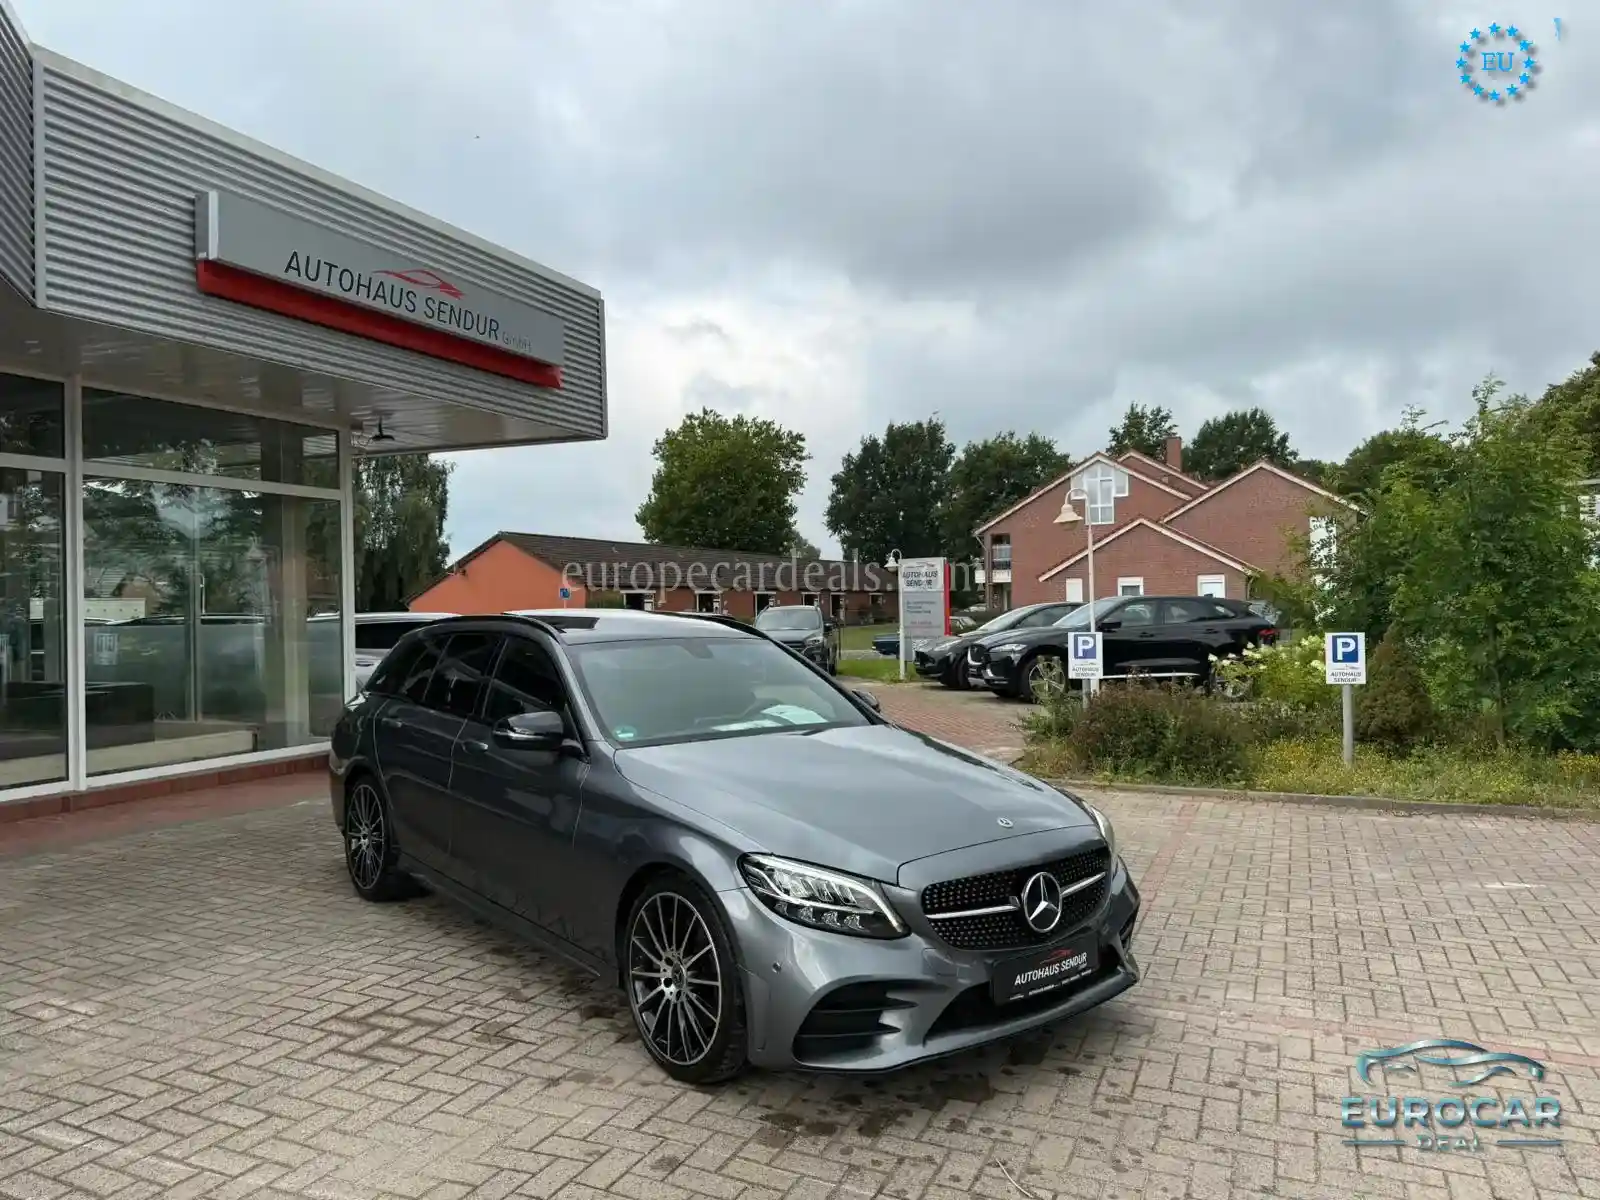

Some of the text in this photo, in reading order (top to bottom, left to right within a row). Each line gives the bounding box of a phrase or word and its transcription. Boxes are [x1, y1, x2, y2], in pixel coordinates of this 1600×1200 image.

[284, 250, 418, 314] AUTOHAUS
[424, 295, 500, 341] SENDUR
[1077, 636, 1094, 657] P
[1336, 637, 1356, 661] P
[1014, 963, 1060, 986] AUTOHAUS
[1060, 952, 1087, 971] SENDUR
